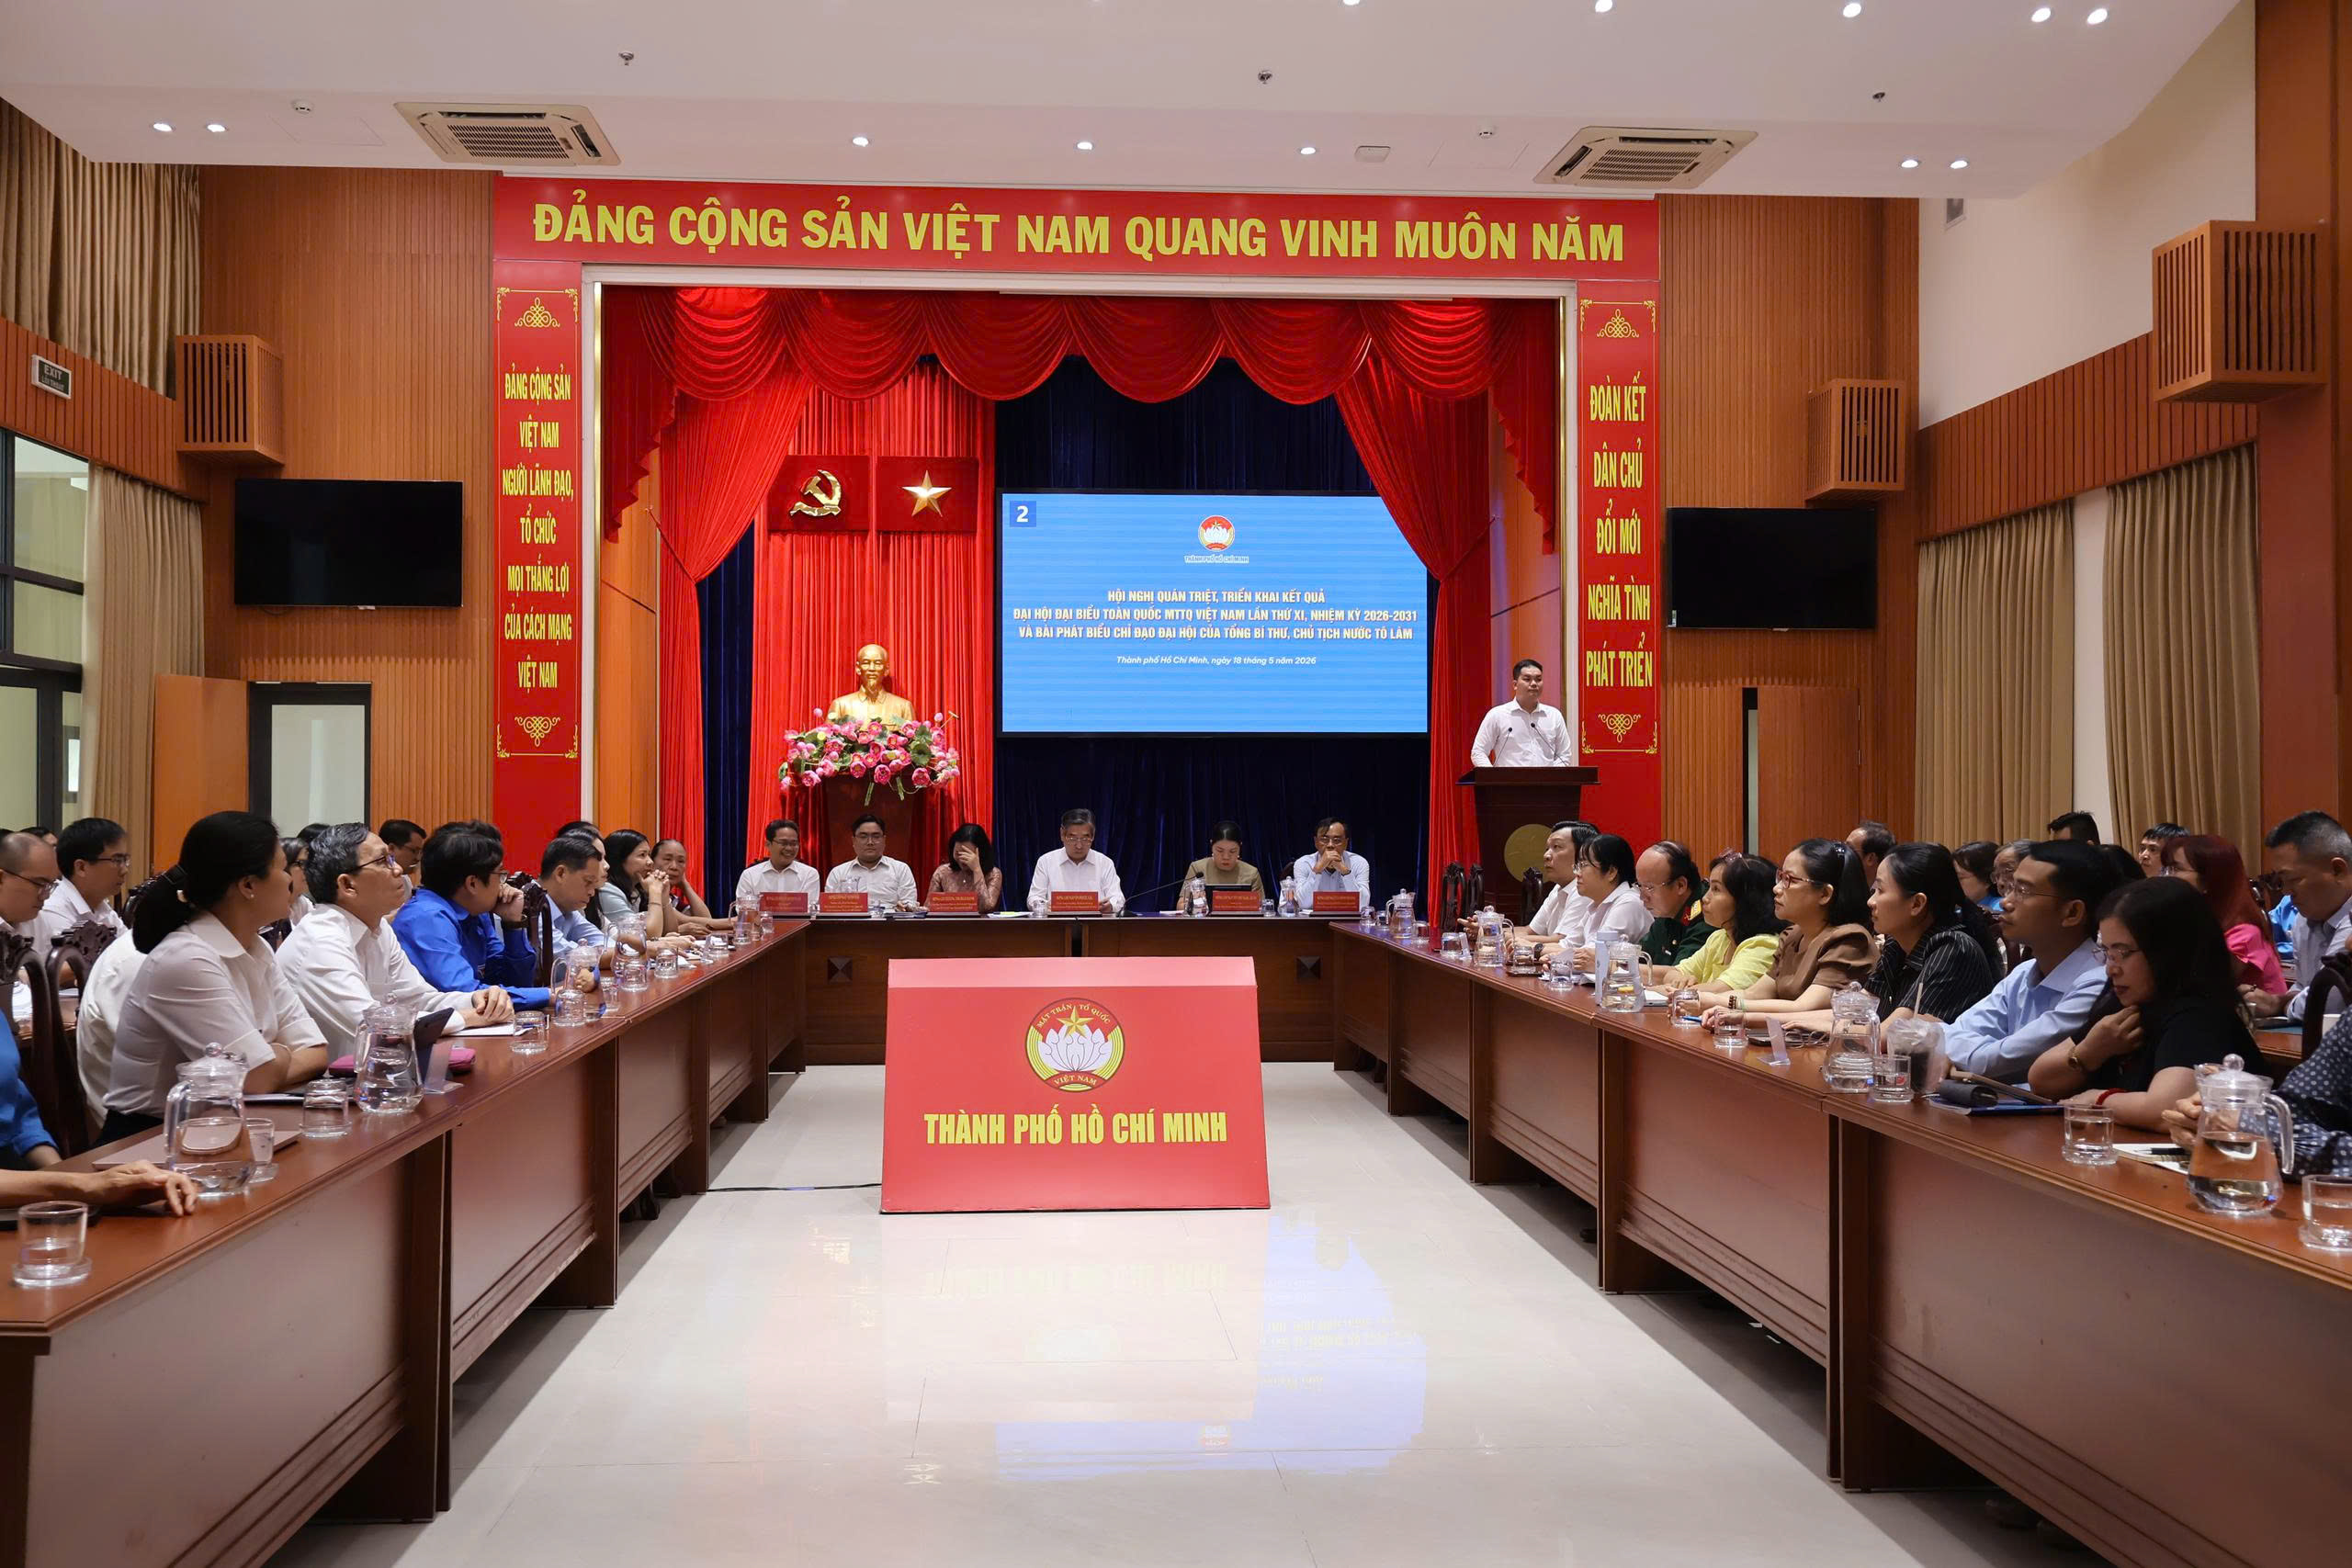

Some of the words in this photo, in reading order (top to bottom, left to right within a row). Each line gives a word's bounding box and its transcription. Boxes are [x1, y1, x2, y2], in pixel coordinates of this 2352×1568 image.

[534, 189, 654, 244] ĐẢNG
[669, 197, 787, 254] CỘNG
[801, 196, 888, 250] SẢN
[903, 203, 1001, 259] VIỆT
[1017, 215, 1109, 254] NAM
[1125, 216, 1267, 262] QUANG
[1280, 219, 1377, 258] VINH
[1395, 211, 1516, 260] MUÔN
[1532, 216, 1623, 262] NĂM
[44, 364, 62, 380] EXIT
[504, 362, 528, 400] ĐẢNG
[529, 367, 552, 403] CỘNG
[553, 364, 571, 400] SẢN
[1589, 378, 1621, 421] ĐOÀN
[1623, 371, 1646, 422] KẾT
[519, 413, 539, 453] VIỆT
[540, 421, 560, 448] NAM
[502, 468, 529, 497] NGƯỜI
[529, 463, 552, 497] LÃNH
[553, 470, 574, 500] ĐẠO,
[1593, 444, 1617, 488] DÂN
[1620, 438, 1643, 488] CHỦ
[520, 504, 532, 545] TỔ
[533, 510, 557, 545] CHỨC
[1016, 507, 1029, 523] 2
[1596, 499, 1616, 554] ĐỔI
[1619, 509, 1642, 554] MỚI
[507, 566, 525, 596] MỌI
[525, 553, 554, 594] THẮNG
[555, 563, 570, 596] LỢI
[1013, 608, 1032, 622] ĐẠI
[1035, 606, 1052, 622] HỘI
[1055, 608, 1073, 622] ĐẠI
[1076, 604, 1100, 620] BIỂU
[1102, 606, 1131, 620] TOÀN
[1134, 605, 1161, 620] QUỐC
[1165, 609, 1193, 621] MTTQ
[1196, 607, 1217, 623] VIỆT
[1220, 609, 1246, 621] NAM
[1272, 607, 1292, 621] THỨ
[1294, 610, 1308, 622] XI,
[1310, 607, 1345, 623] NHIỆM
[1364, 610, 1418, 622] 2026-2031
[1108, 589, 1125, 604] HỘI
[1129, 591, 1154, 604] NGHỊ
[1157, 589, 1186, 603] QUÁN
[1189, 589, 1219, 604] TRIỆT,
[1255, 592, 1279, 603] KHAI
[1283, 589, 1301, 603] KẾT
[1305, 588, 1326, 604] QUẢ
[1588, 576, 1621, 620] NGHĨA
[1623, 575, 1651, 620] TÌNH
[504, 604, 522, 640] CỦA
[523, 604, 545, 641] CÁCH
[548, 614, 572, 646] MẠNG
[1019, 625, 1033, 638] VÀ
[1035, 625, 1053, 638] BÀI
[1057, 625, 1083, 638] PHÁT
[1086, 623, 1111, 638] BIỂU
[1134, 626, 1156, 640] ĐẠO
[1158, 626, 1176, 640] ĐẠI
[1179, 625, 1197, 640] HỘI
[1200, 624, 1220, 638] CỦA
[1224, 624, 1250, 638] TỔNG
[1254, 626, 1265, 638] BÍ
[1293, 625, 1314, 639] CHỦ
[1317, 627, 1340, 641] TỊCH
[1374, 626, 1387, 639] TÔ
[1390, 626, 1413, 639] LÂM
[518, 654, 537, 694] VIỆT
[538, 661, 558, 688] NAM
[1117, 656, 1142, 664] Thành
[1143, 655, 1159, 665] phố
[1173, 656, 1188, 664] Chí
[1189, 656, 1210, 665] Minh,
[1211, 657, 1232, 666] ngày
[1243, 657, 1267, 666] tháng
[1586, 644, 1615, 687] PHÁT
[1618, 632, 1653, 687] TRIỂN
[1054, 1075, 1075, 1085] VIỆT
[1078, 1075, 1097, 1085] NAM
[923, 1109, 1006, 1145] THÀNH
[1013, 1103, 1062, 1145] PHỐ
[1071, 1103, 1103, 1144] HỒ
[1113, 1108, 1155, 1144] CHÍ
[1162, 1111, 1227, 1142] MINH
